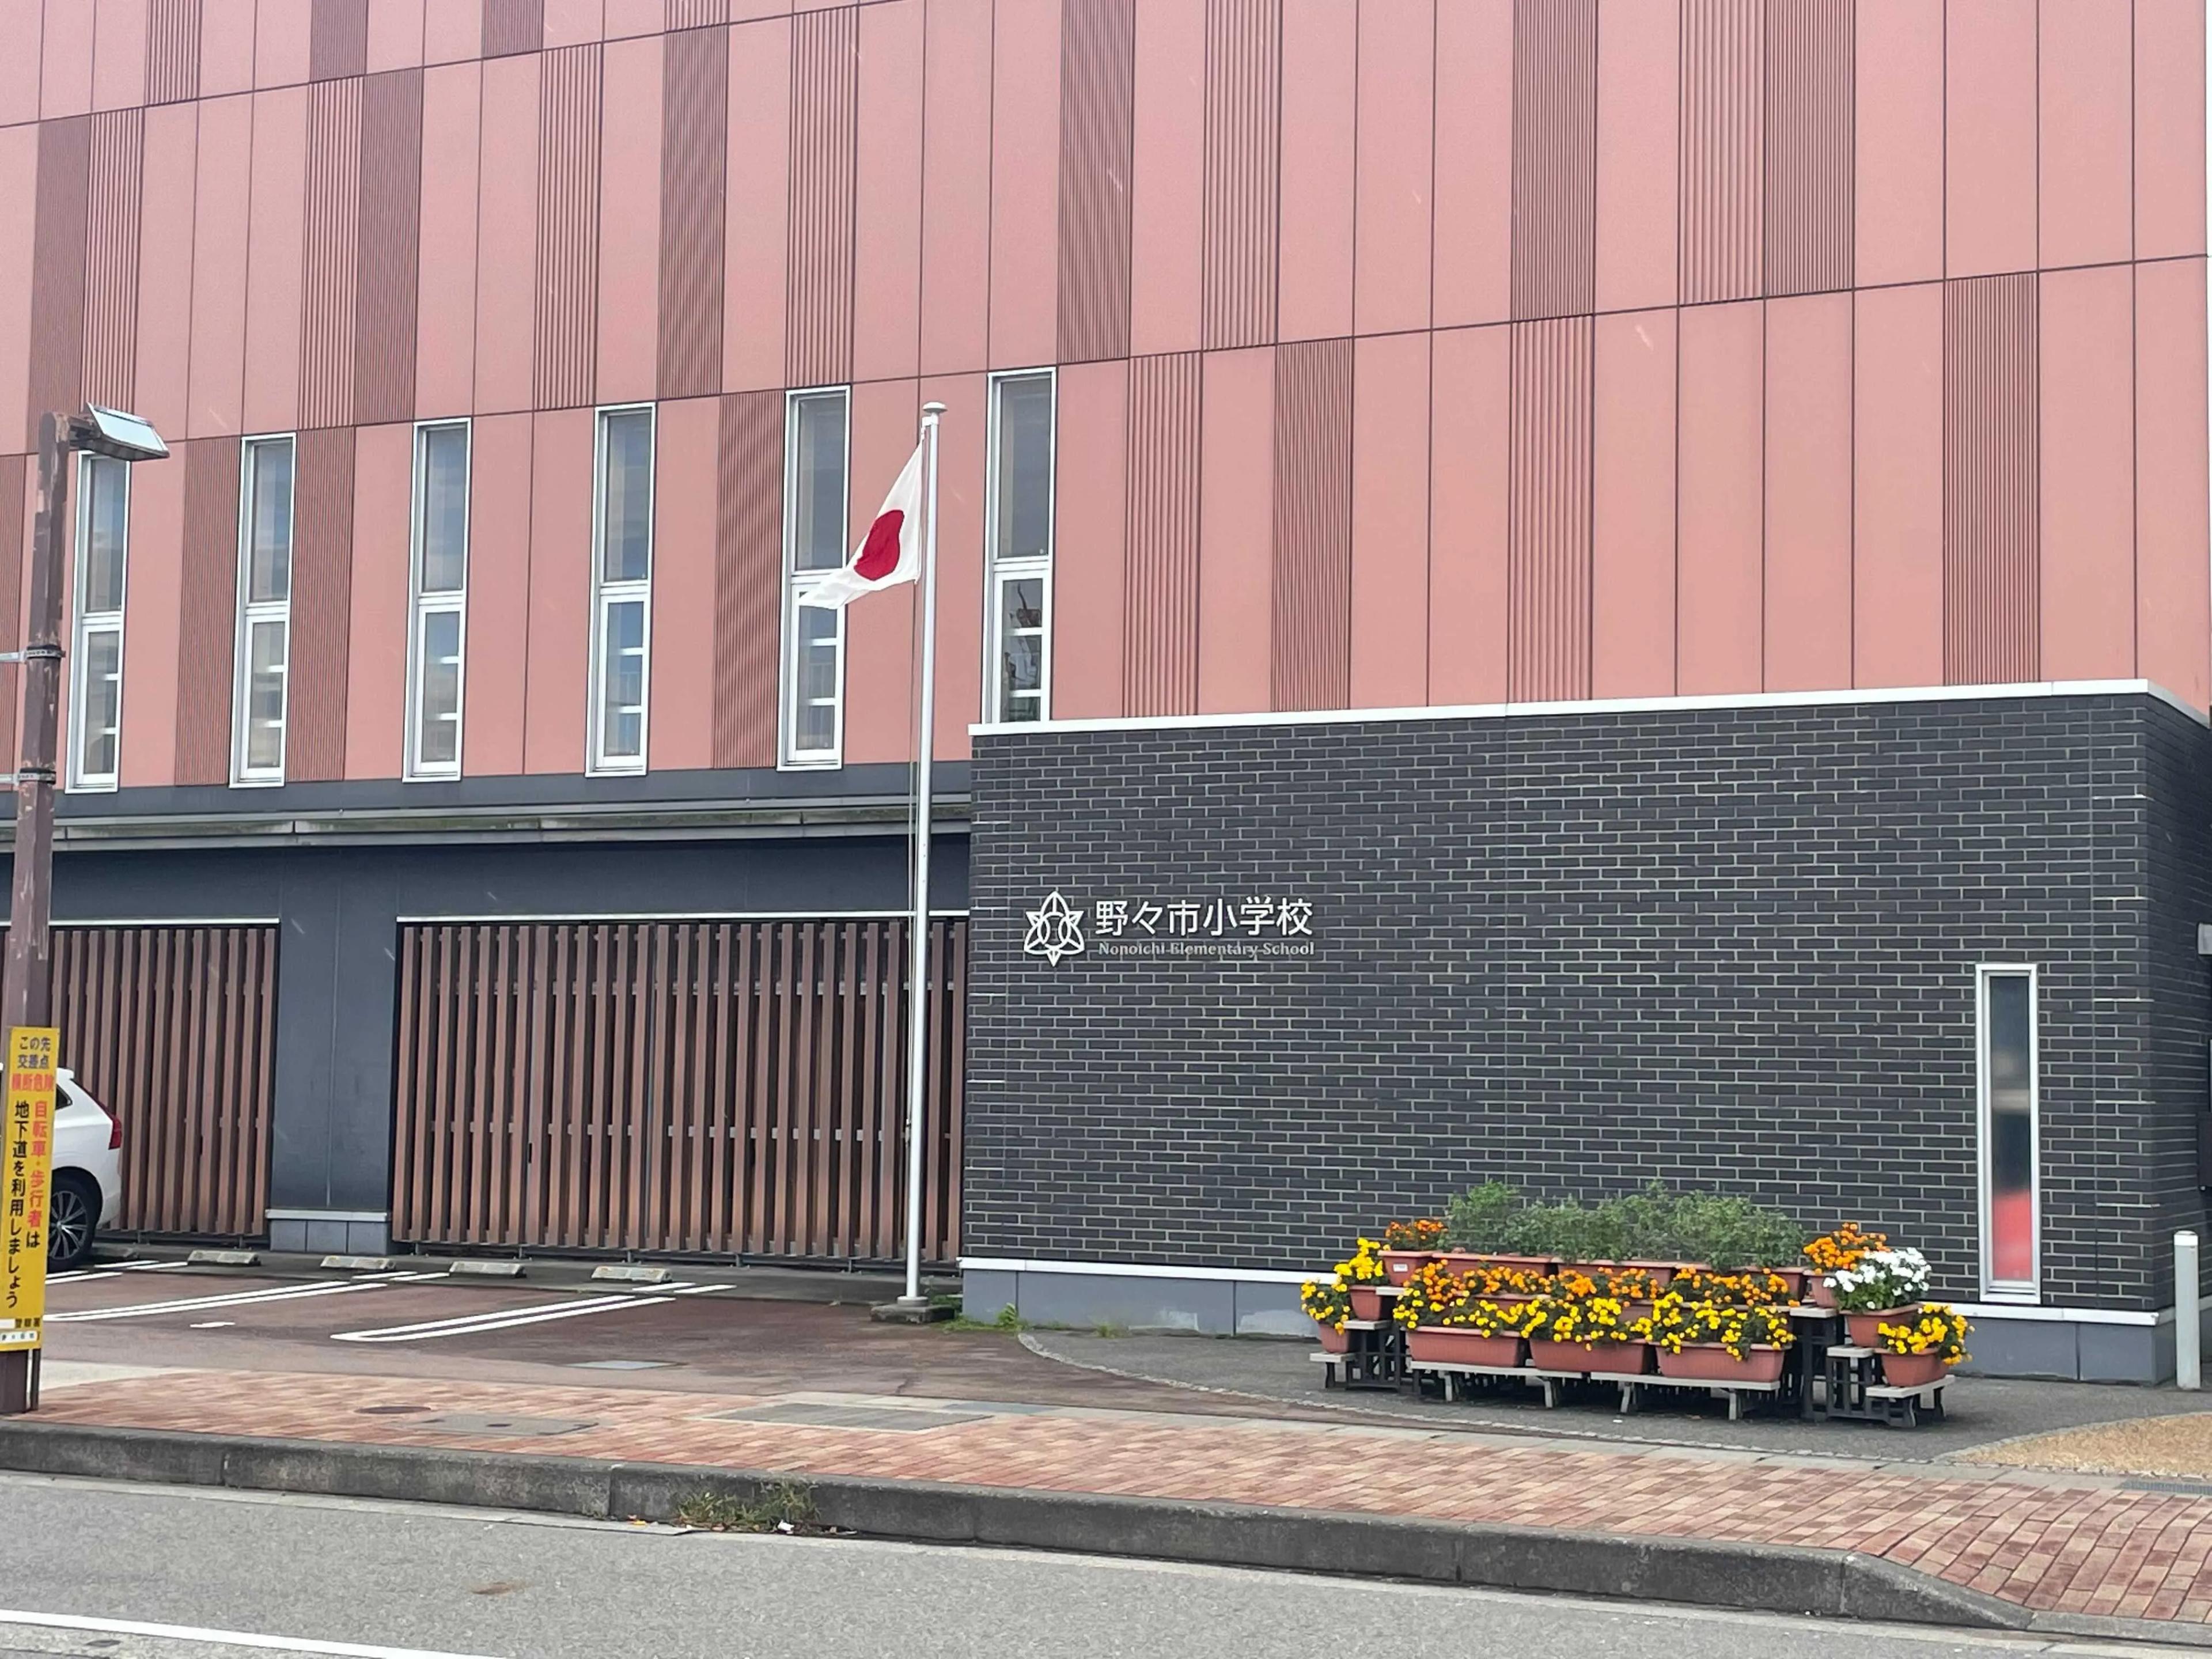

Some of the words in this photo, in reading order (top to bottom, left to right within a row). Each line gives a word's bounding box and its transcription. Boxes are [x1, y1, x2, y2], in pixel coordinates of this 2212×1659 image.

[1096, 896, 1313, 937] 野々市小学校
[1098, 942, 1165, 955] Nonoichi
[1170, 942, 1258, 958] Elementary
[1263, 942, 1315, 955] School
[20, 1036, 51, 1052] この先
[17, 1054, 50, 1070] 交差点
[26, 1101, 48, 1248] 自転車・歩行者は
[6, 1100, 30, 1309] 地下道を利用しましょう
